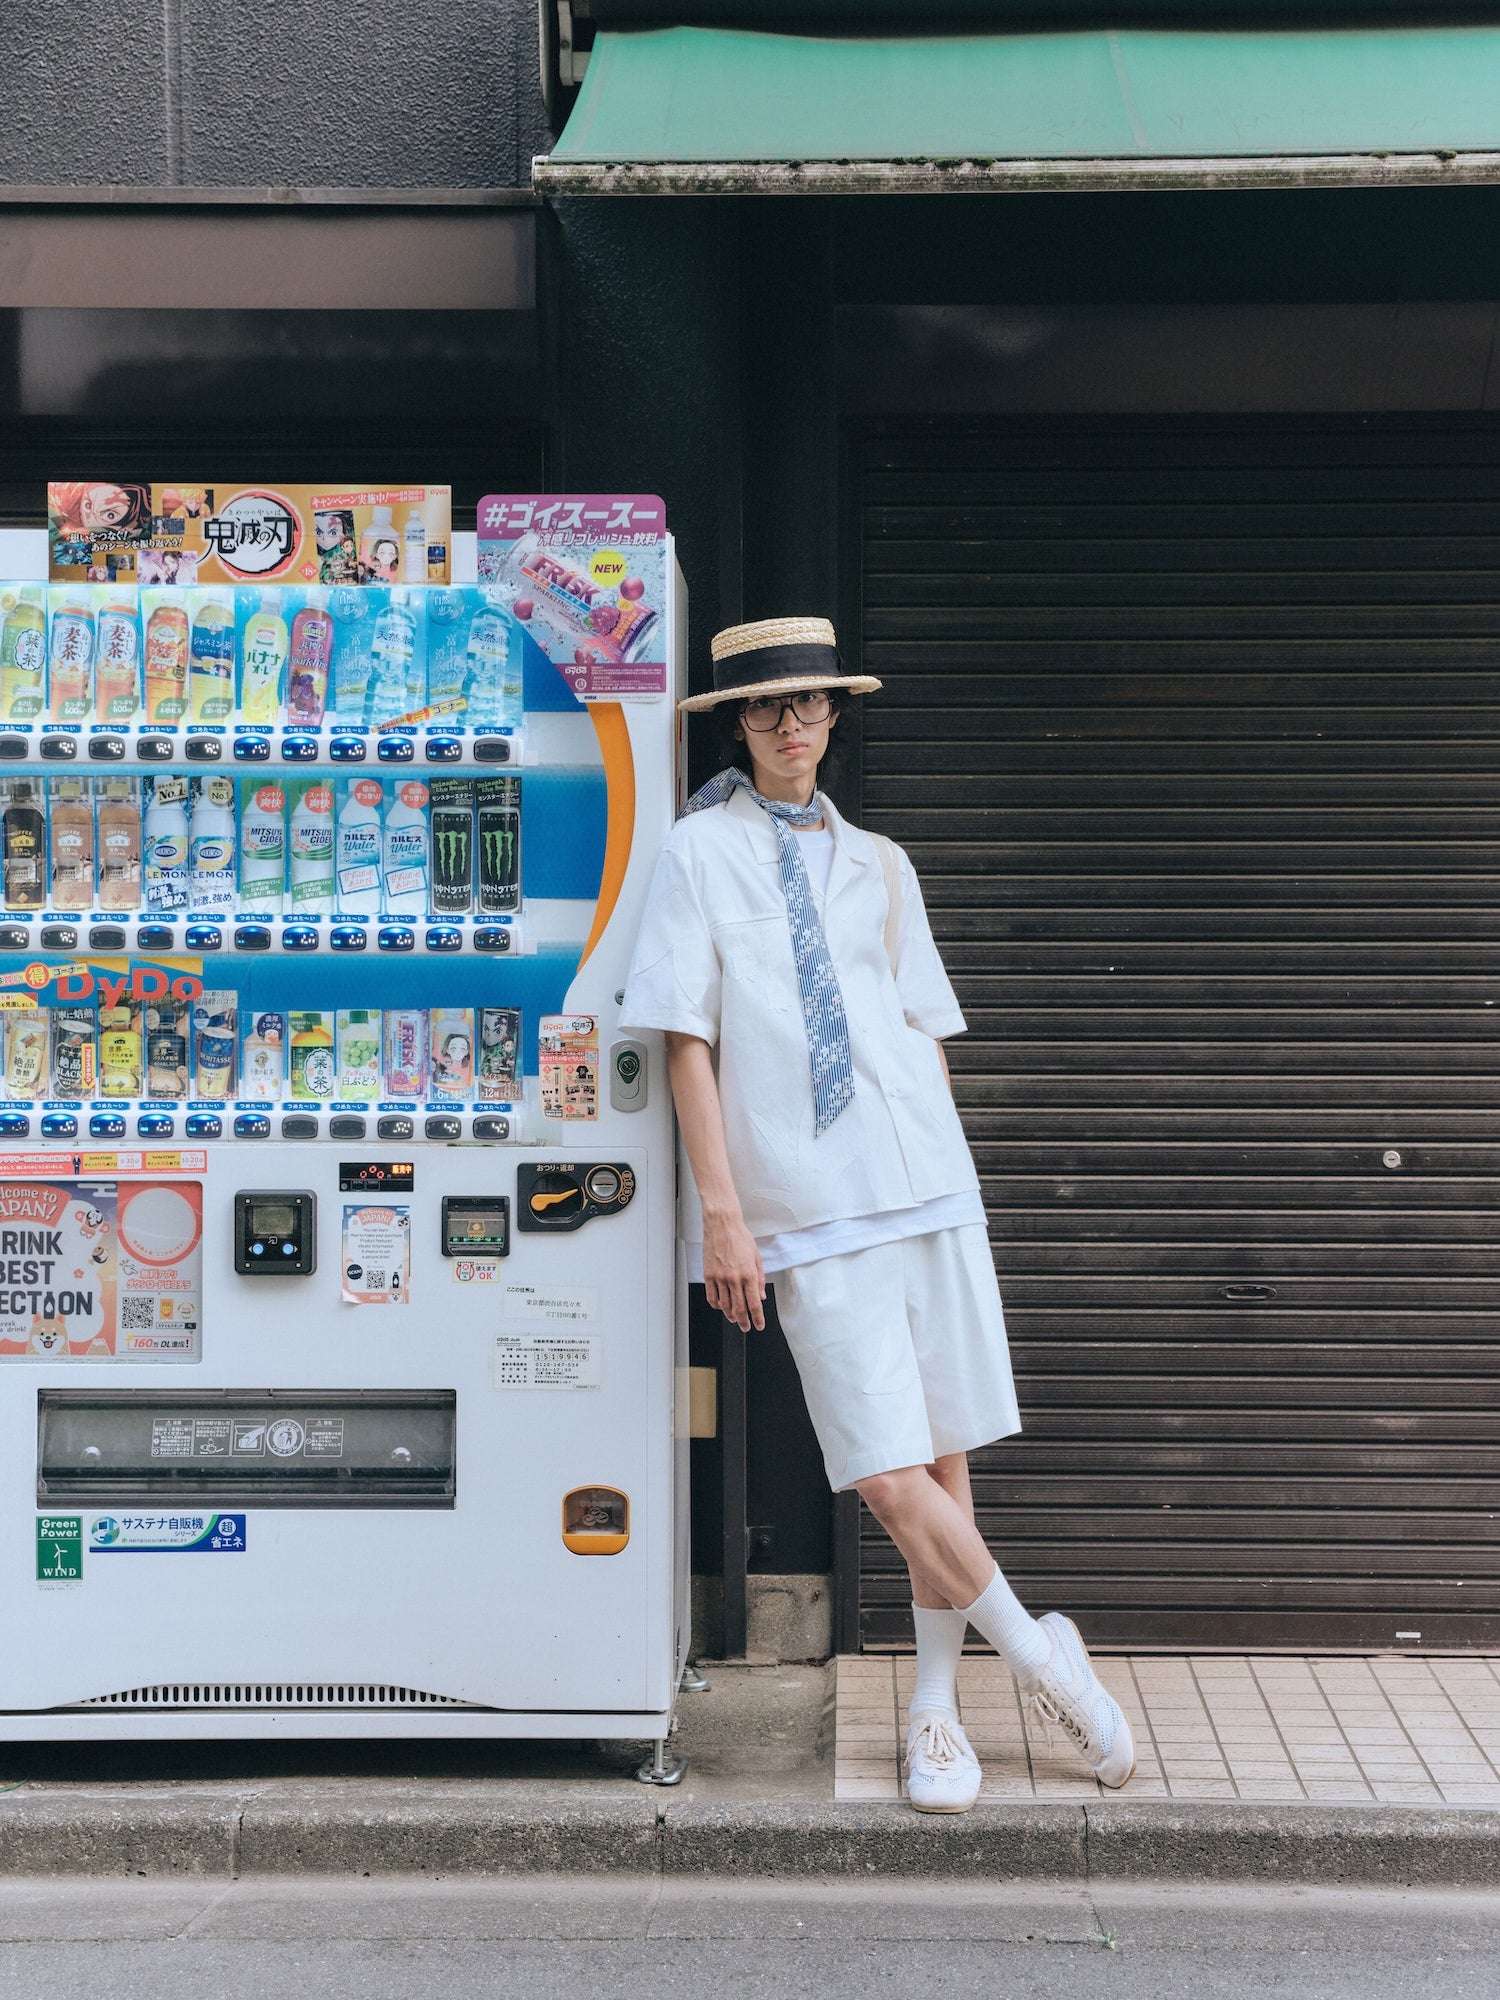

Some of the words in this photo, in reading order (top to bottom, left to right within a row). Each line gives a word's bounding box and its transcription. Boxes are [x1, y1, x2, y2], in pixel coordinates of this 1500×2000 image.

[228, 508, 282, 517] きめつのやいば
[484, 500, 658, 529] #ゴイスースー
[196, 515, 295, 562] 鬼滅の刃
[537, 530, 658, 547] 冷感リフレッシュ飲料
[594, 564, 623, 574] NEW
[530, 553, 601, 606] FRISK
[62, 626, 80, 661] 麦茶
[107, 625, 126, 660] 麦茶
[193, 637, 233, 651] ジャスミン茶
[22, 633, 40, 668] 葉の茶
[247, 651, 281, 666] バナナ
[565, 666, 587, 675] DyDo
[432, 793, 473, 801] モンスターエナジー
[478, 792, 519, 801] モンスターエナジー
[260, 798, 282, 808] 爽快
[343, 841, 376, 851] Water
[390, 843, 423, 853] Water
[147, 871, 187, 879] LEMON
[193, 871, 234, 879] LEMON
[29, 966, 47, 984] 得
[58, 968, 204, 1010] DyDo
[402, 1025, 414, 1068] FRISK
[314, 1055, 328, 1089] 葉の茶
[342, 1076, 377, 1086] 白ぶどう
[536, 1164, 575, 1172] おつり・返却
[43, 1190, 58, 1203] to
[2, 1231, 63, 1255] RINK
[479, 1272, 492, 1280] OK
[41, 1519, 77, 1529] Green
[121, 1517, 204, 1530] サステナ自販機
[219, 1520, 234, 1533] 超
[40, 1529, 78, 1538] Power
[211, 1536, 243, 1548] 省エネ
[43, 1567, 77, 1577] WIND
